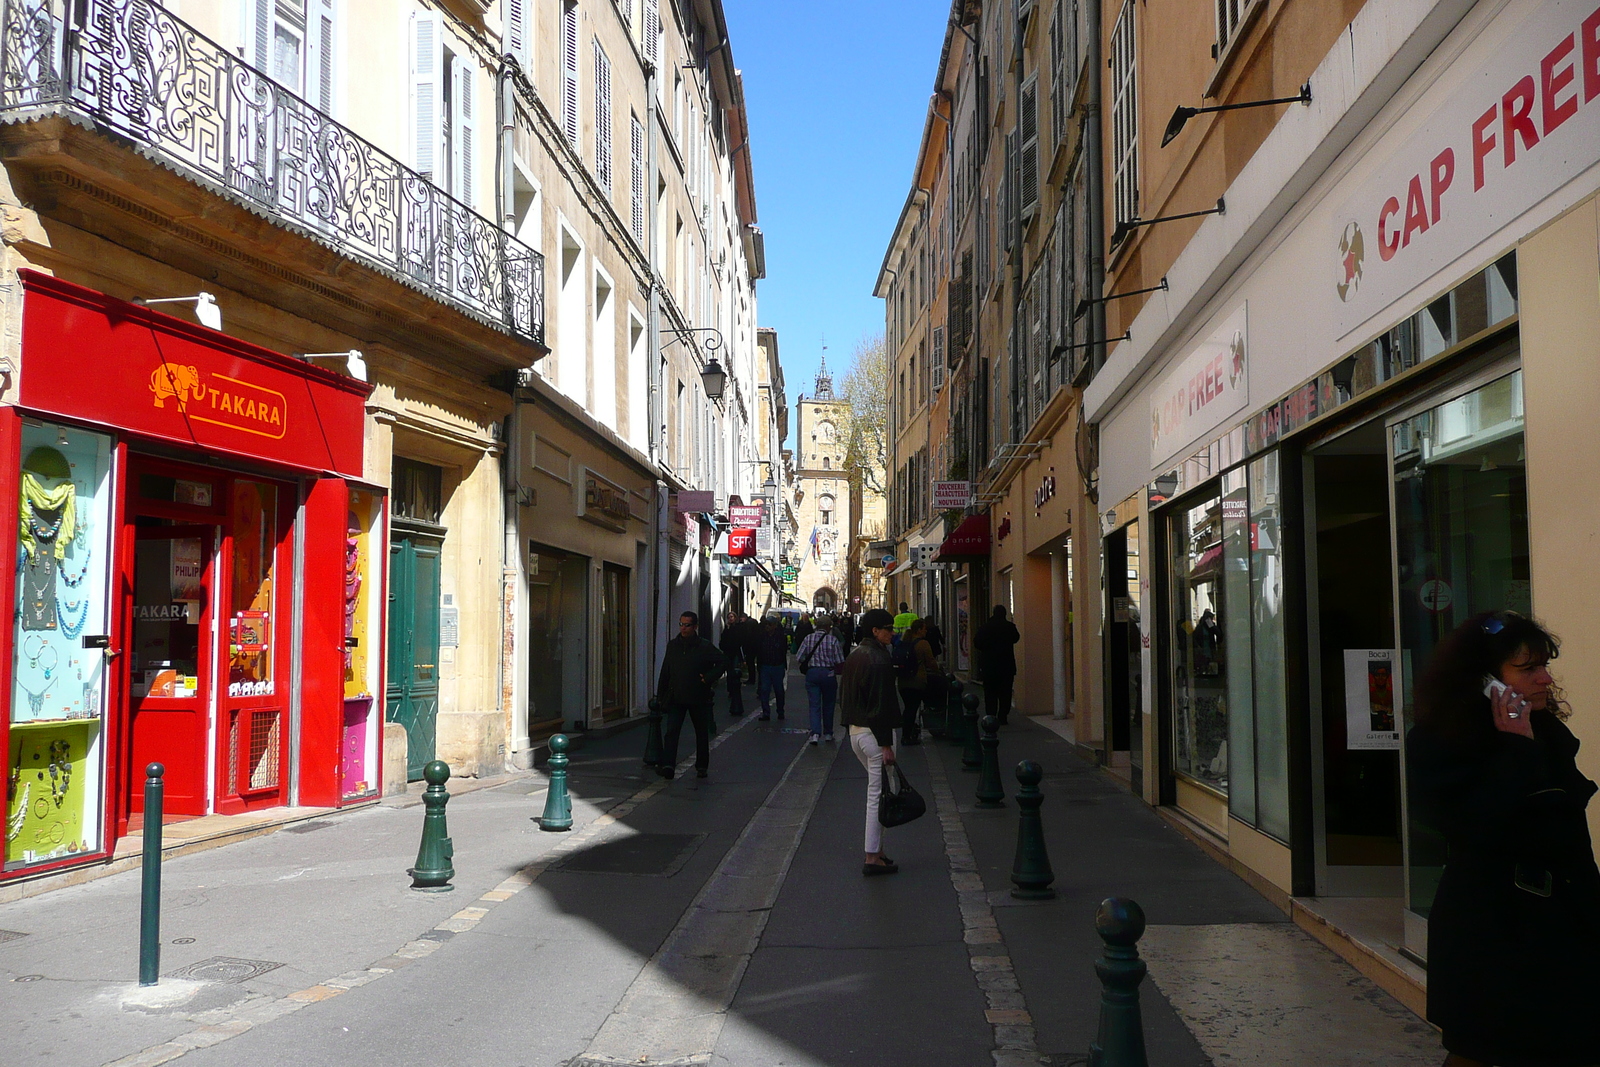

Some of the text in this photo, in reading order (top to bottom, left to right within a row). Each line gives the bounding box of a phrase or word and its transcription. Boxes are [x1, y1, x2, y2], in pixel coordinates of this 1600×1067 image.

[1377, 147, 1455, 262] CAP
[208, 387, 281, 426] TAKARA
[1163, 353, 1223, 435] CAP FREE
[1260, 384, 1316, 440] CAP FREE
[935, 490, 969, 498] CHARCUTERIE
[732, 536, 752, 548] SFR
[132, 604, 188, 618] TAKARA
[1368, 651, 1390, 659] Bocaj
